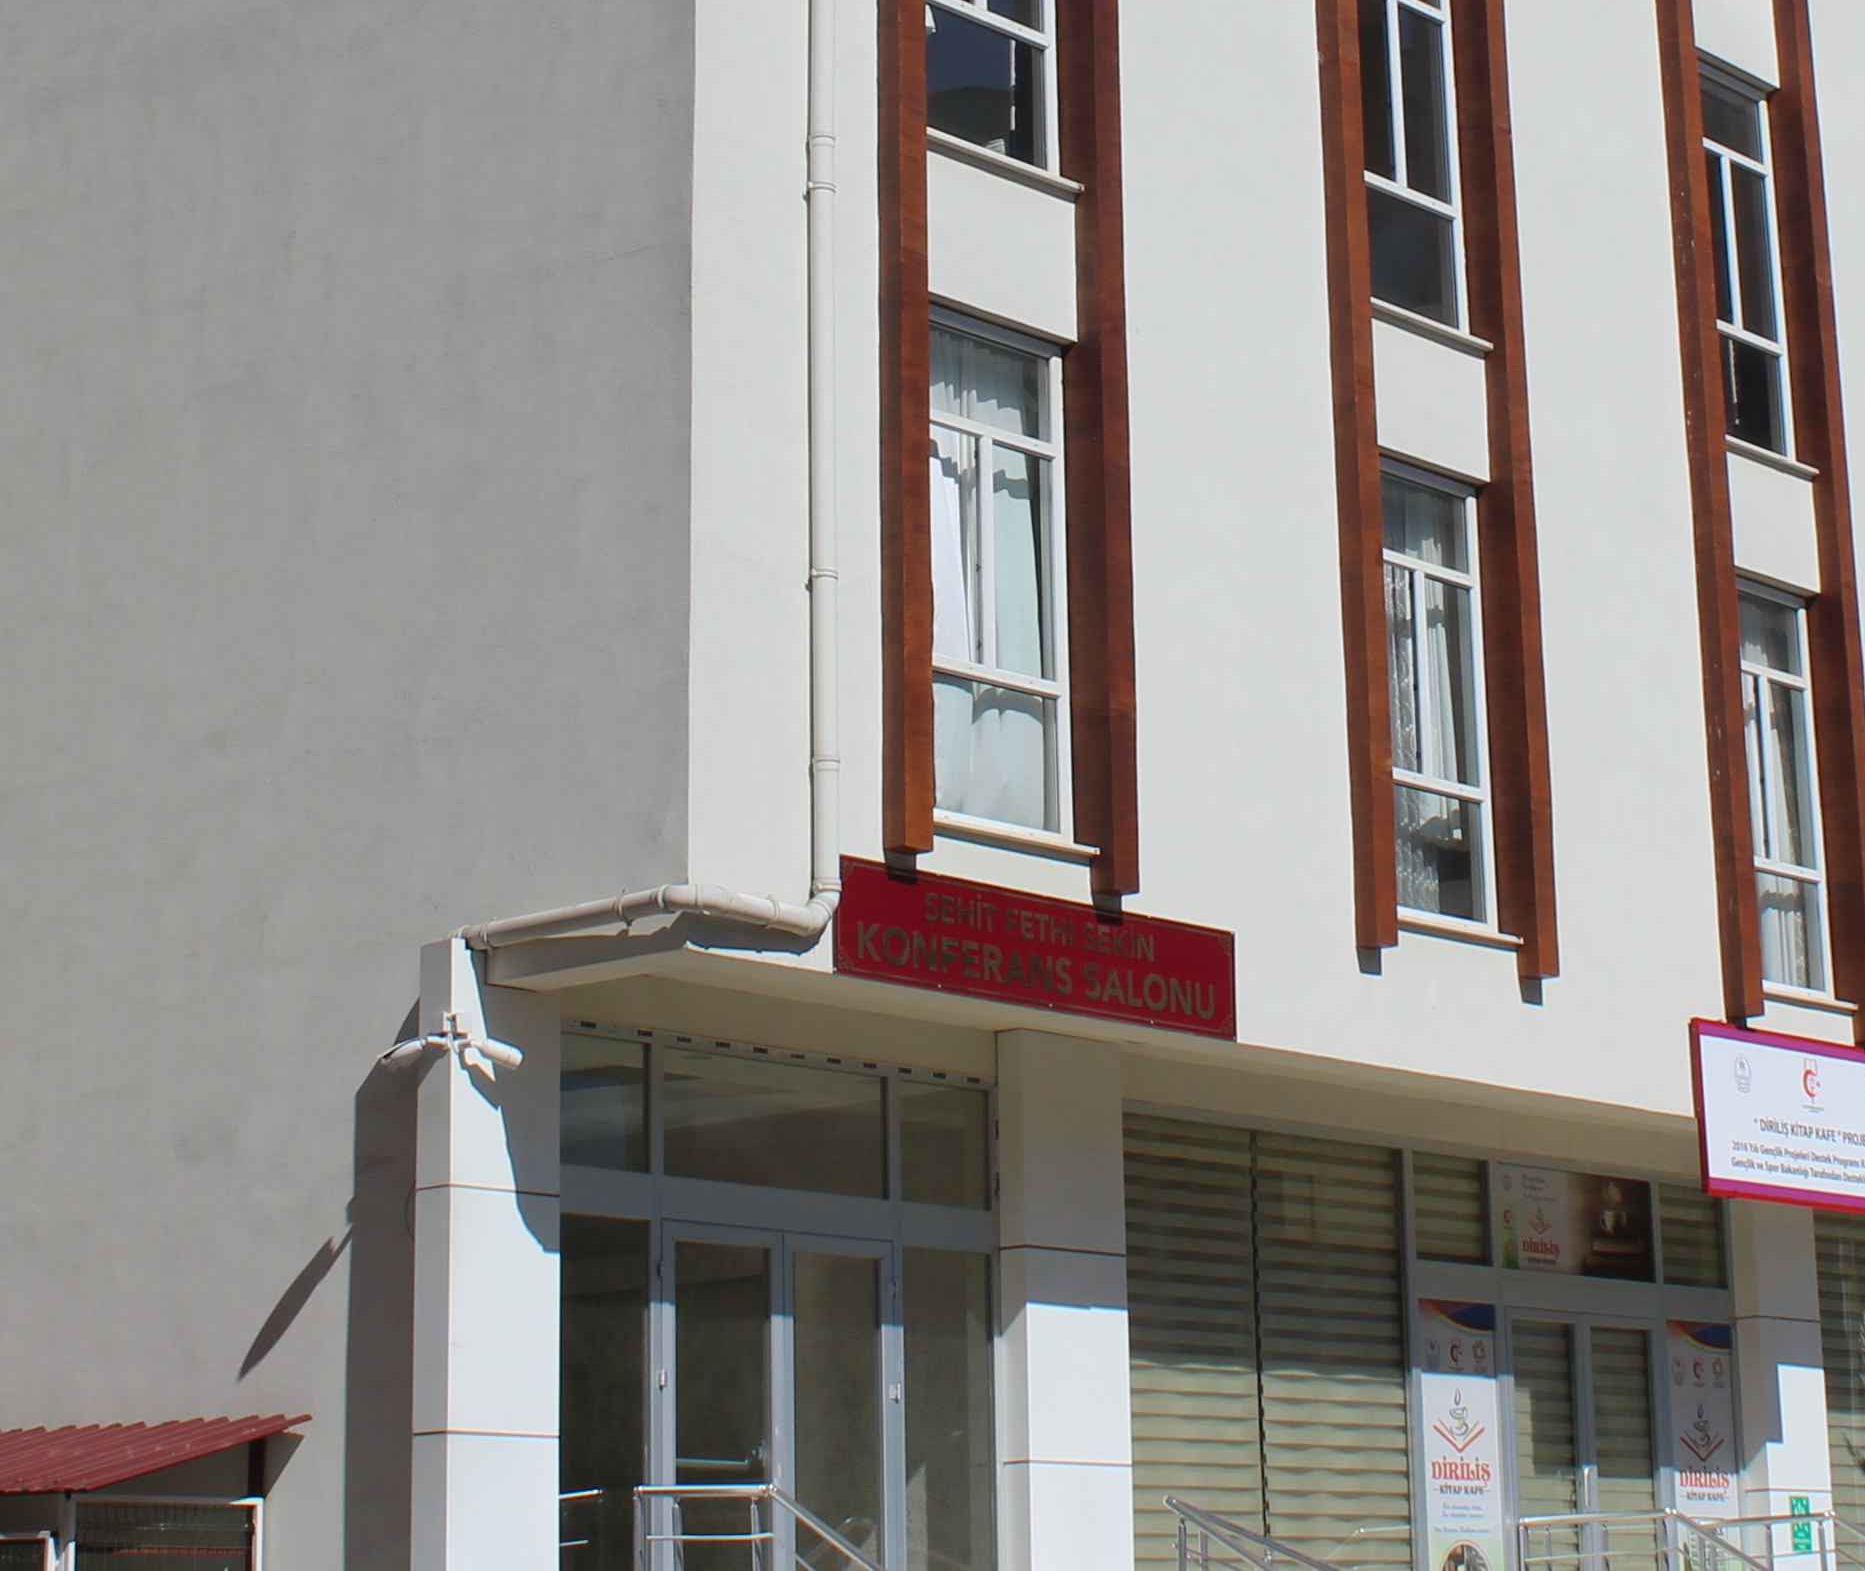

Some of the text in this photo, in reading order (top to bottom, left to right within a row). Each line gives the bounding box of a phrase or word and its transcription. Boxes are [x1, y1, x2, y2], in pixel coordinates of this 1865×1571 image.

[924, 892, 1155, 962] ŞEHİT FETHİ SEKİN
[857, 921, 1216, 1020] KONFERANS SALONU
[1759, 1117, 1788, 1139] DİRİLİŞ
[1790, 1121, 1814, 1139] KİTAP
[1815, 1127, 1837, 1142] KAFE
[1431, 1455, 1491, 1488] DİRİLİŞ
[1679, 1465, 1730, 1495] DİRİLİŞ
[1439, 1482, 1485, 1495] KİTAP KAFE
